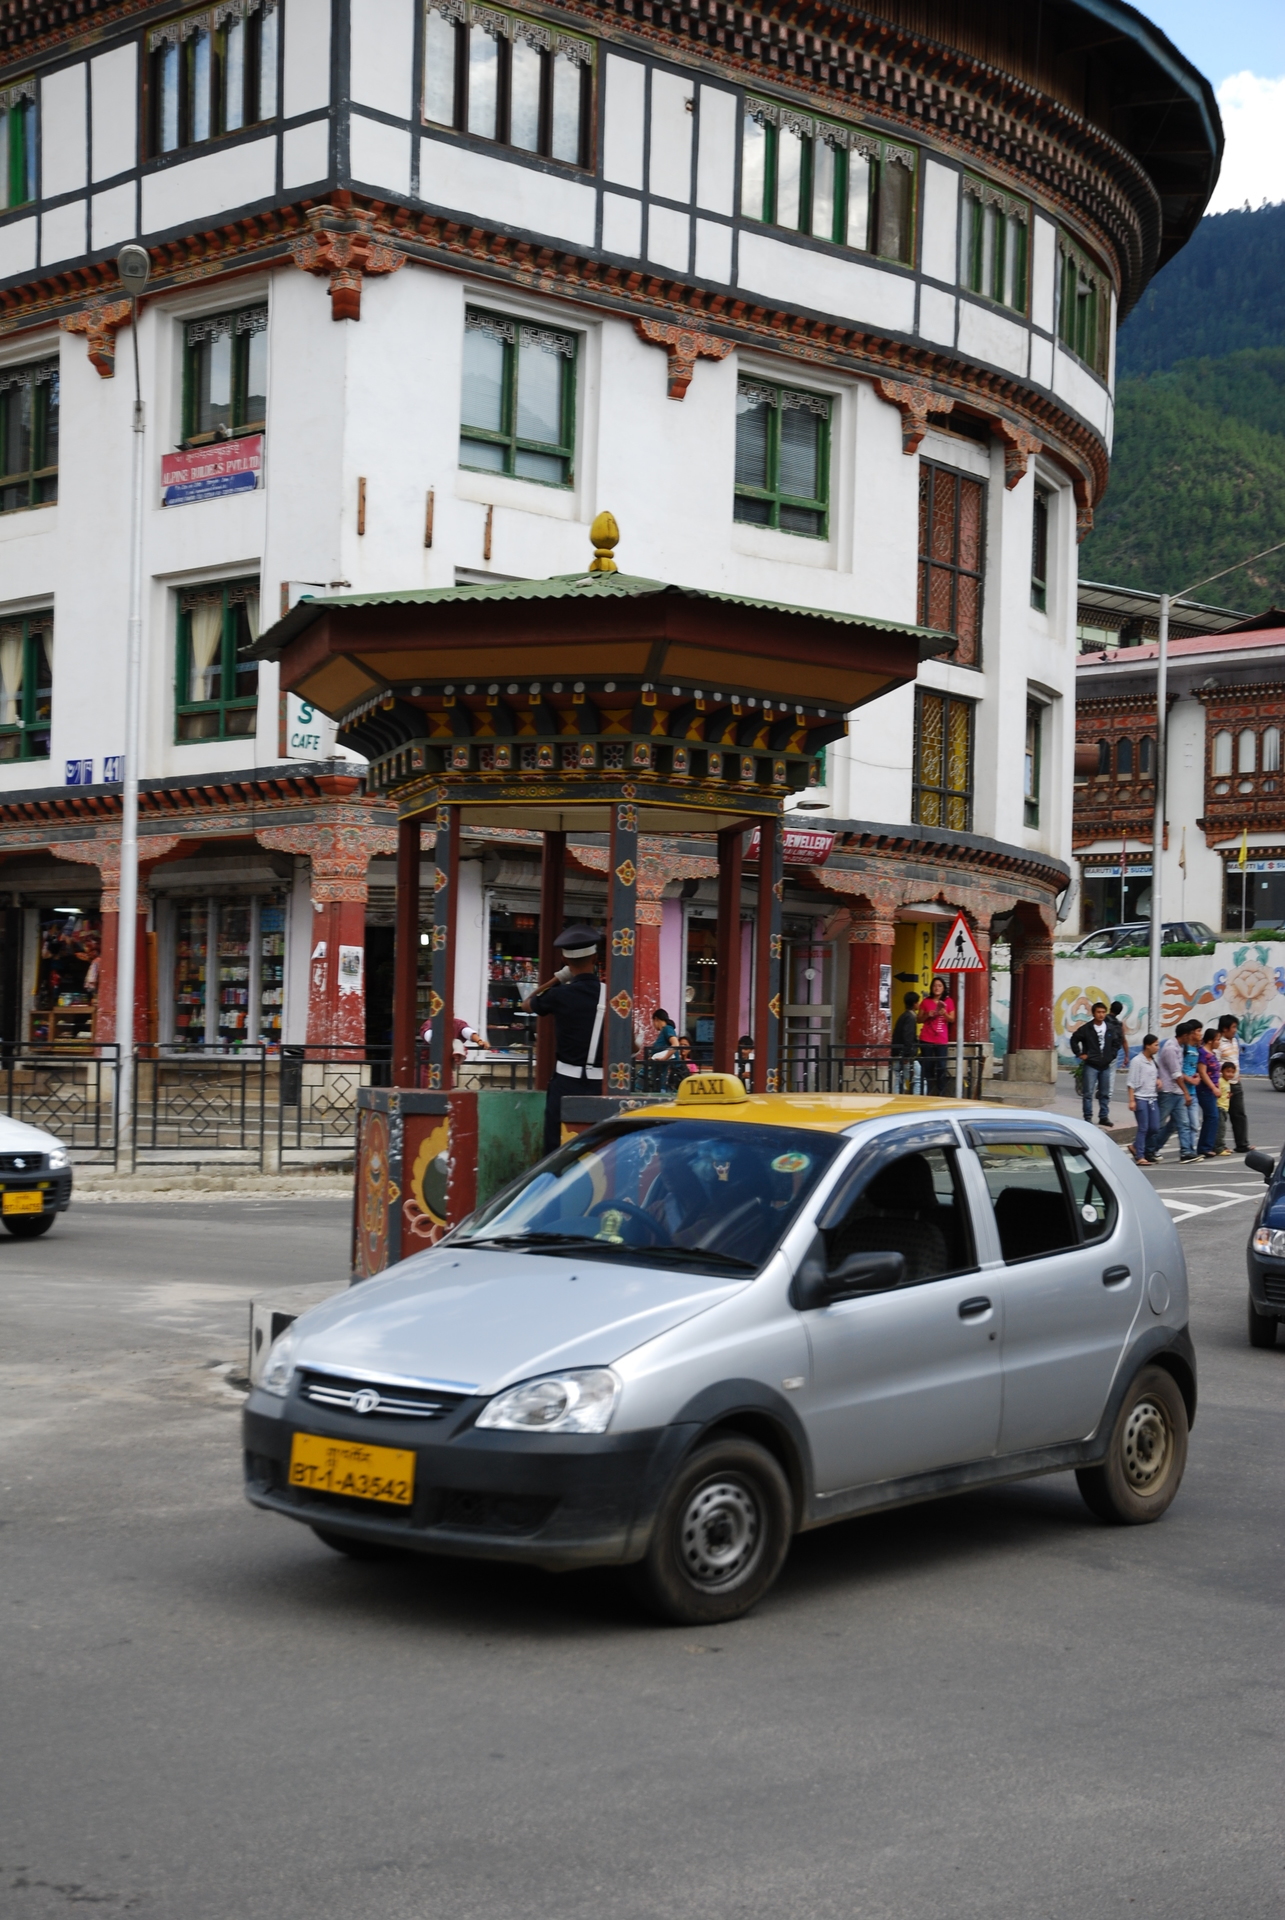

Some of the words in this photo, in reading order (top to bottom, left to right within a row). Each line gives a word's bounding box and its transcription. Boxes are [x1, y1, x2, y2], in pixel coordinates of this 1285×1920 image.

[163, 470, 188, 484] ALPINE
[291, 733, 320, 750] CAFE
[783, 834, 832, 850] JEWELLERY
[687, 1079, 724, 1095] TAXI
